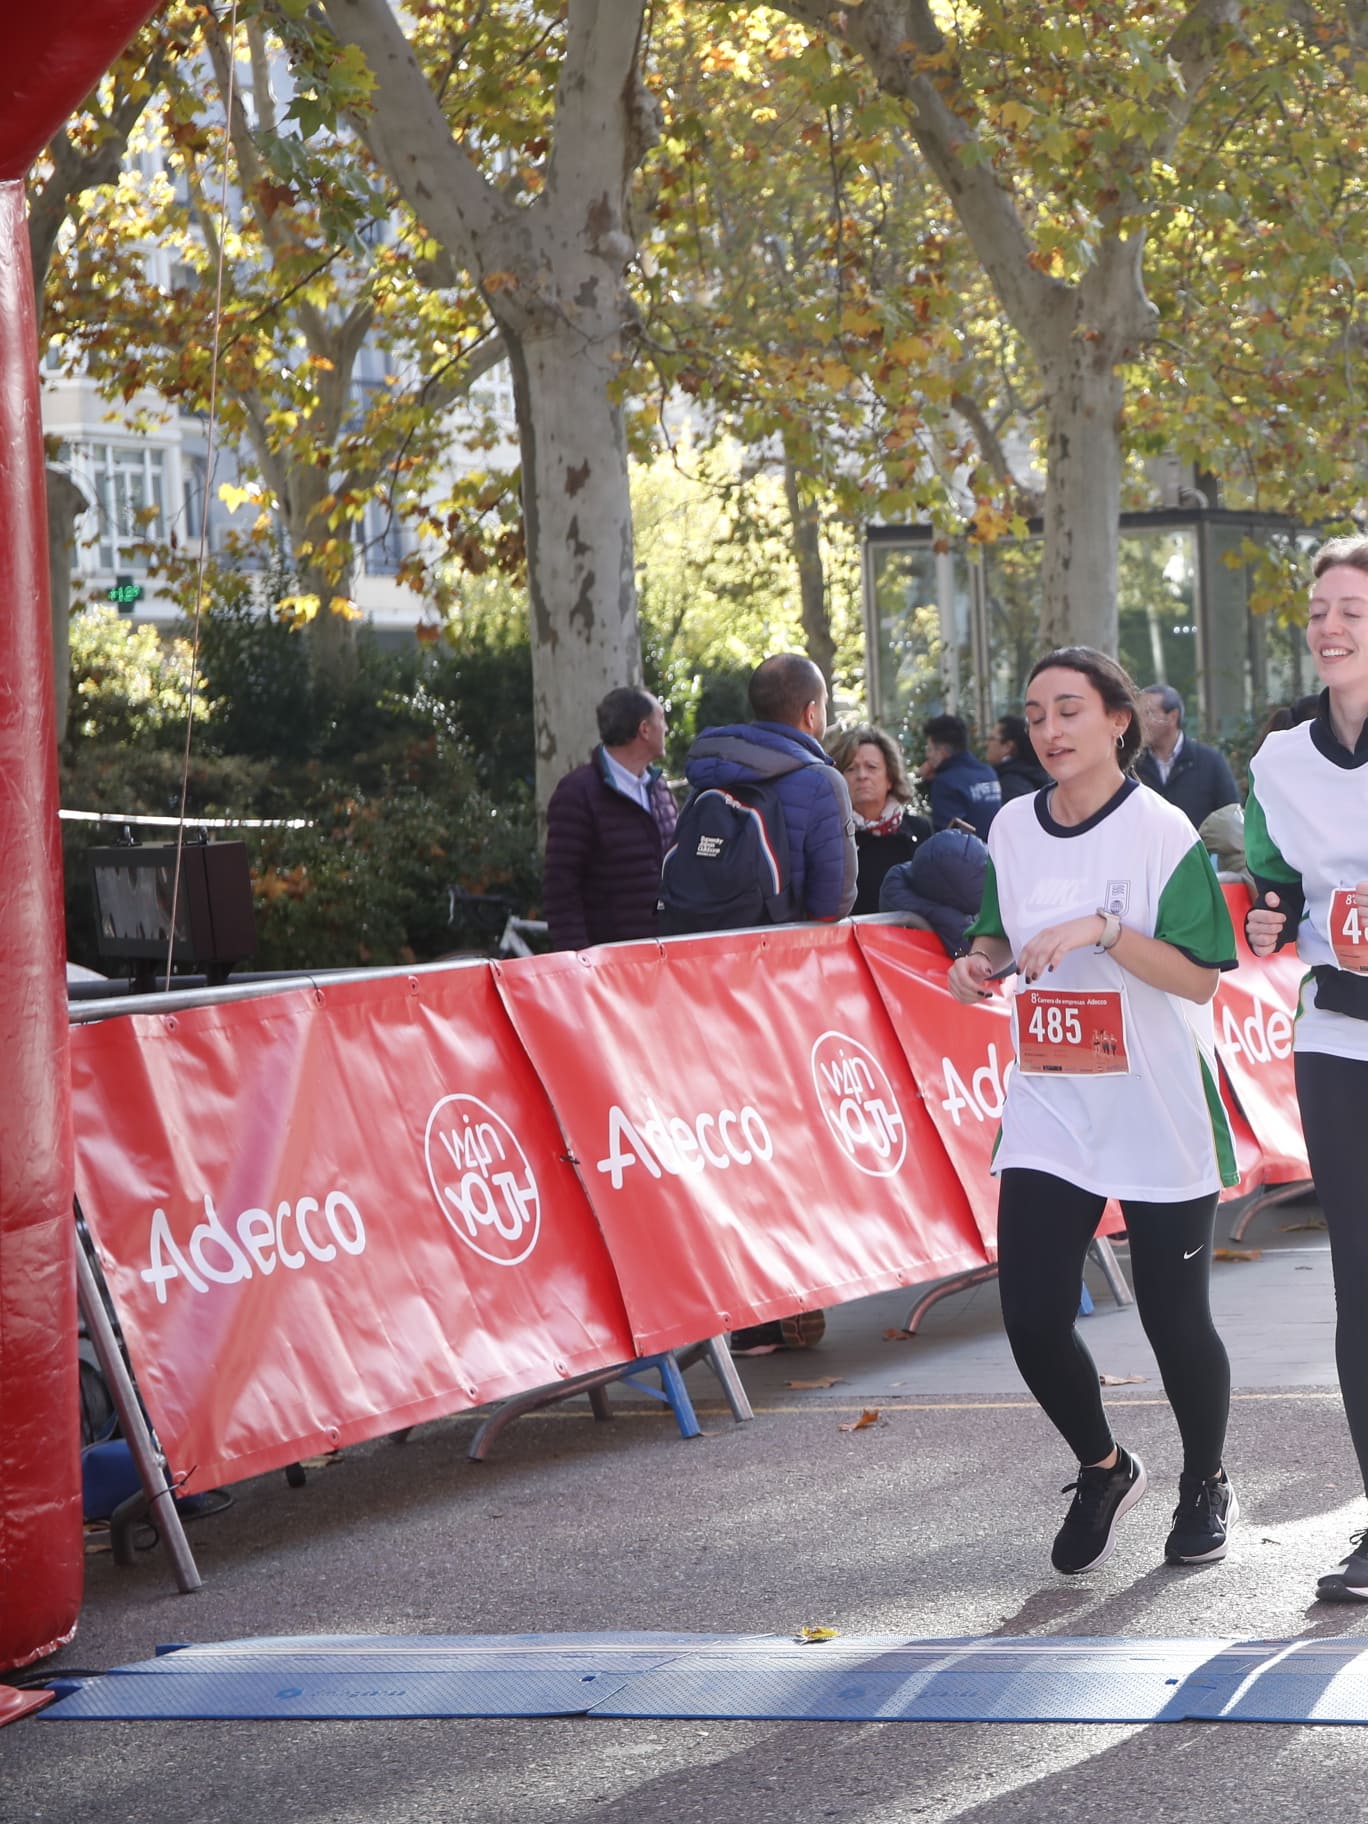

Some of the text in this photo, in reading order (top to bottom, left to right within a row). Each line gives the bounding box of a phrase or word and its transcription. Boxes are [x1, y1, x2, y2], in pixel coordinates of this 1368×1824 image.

[1028, 1005, 1082, 1044] 485
[1221, 996, 1293, 1068] Ade
[596, 1097, 774, 1191] Adecco
[141, 1193, 366, 1305] Adecco
